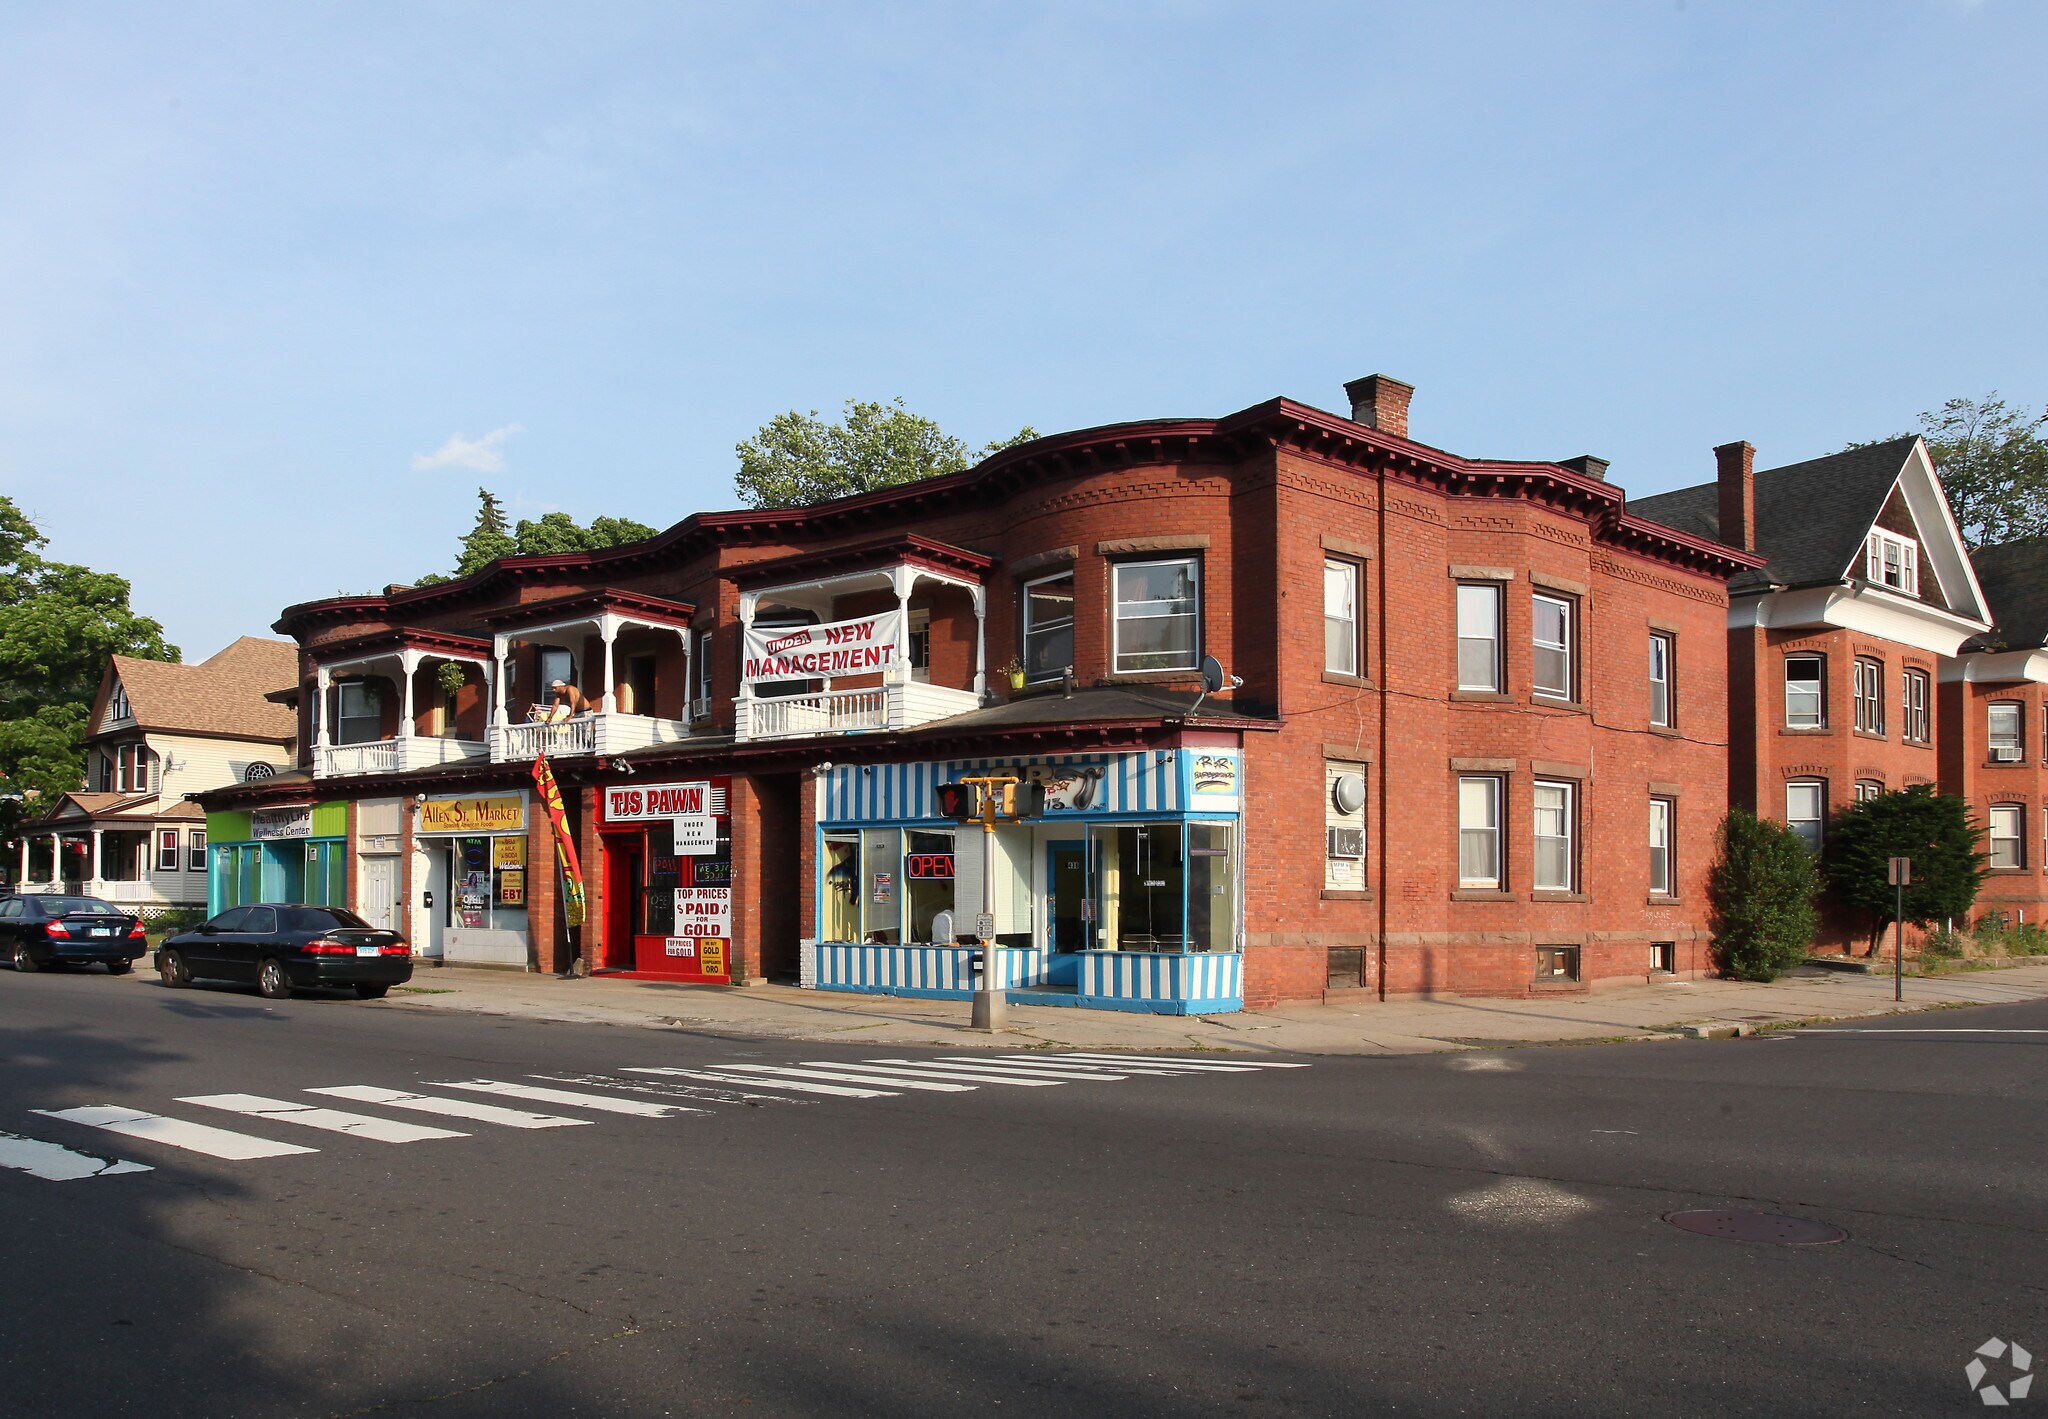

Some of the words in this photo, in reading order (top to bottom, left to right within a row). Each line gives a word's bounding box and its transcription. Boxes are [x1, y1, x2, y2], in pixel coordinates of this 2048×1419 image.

[767, 632, 811, 654] UNDER
[825, 621, 875, 646] NEW
[745, 643, 895, 678] MANAGEMENT
[611, 791, 642, 816] TJS
[647, 787, 703, 815] PAWN
[253, 827, 284, 838] Wellness
[285, 825, 310, 836] Center
[911, 856, 955, 877] OPEN
[503, 889, 522, 900] EBT
[677, 889, 694, 899] TOP
[697, 889, 728, 899] PRICES
[686, 903, 719, 915] PAID
[683, 923, 721, 936] GOLD
[675, 948, 692, 956] GOLD
[703, 946, 719, 955] GOLD
[705, 965, 719, 973] ORO
